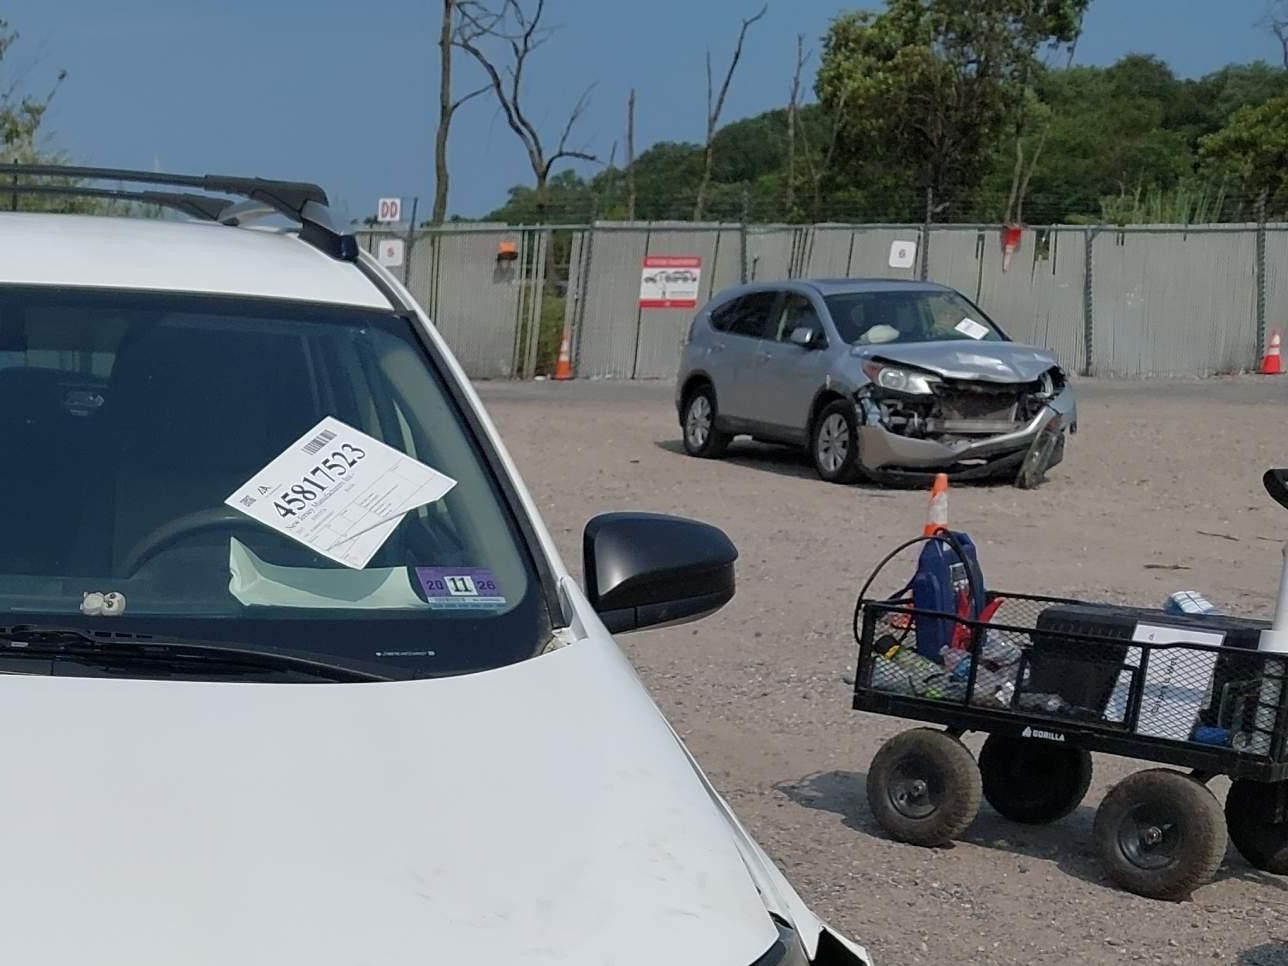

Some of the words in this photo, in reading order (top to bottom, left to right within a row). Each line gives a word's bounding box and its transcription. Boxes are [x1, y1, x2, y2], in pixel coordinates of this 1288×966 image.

[381, 201, 398, 218] DD
[274, 443, 365, 518] 45817523
[426, 580, 444, 590] 20
[448, 577, 472, 592] 11
[477, 580, 496, 590] 26
